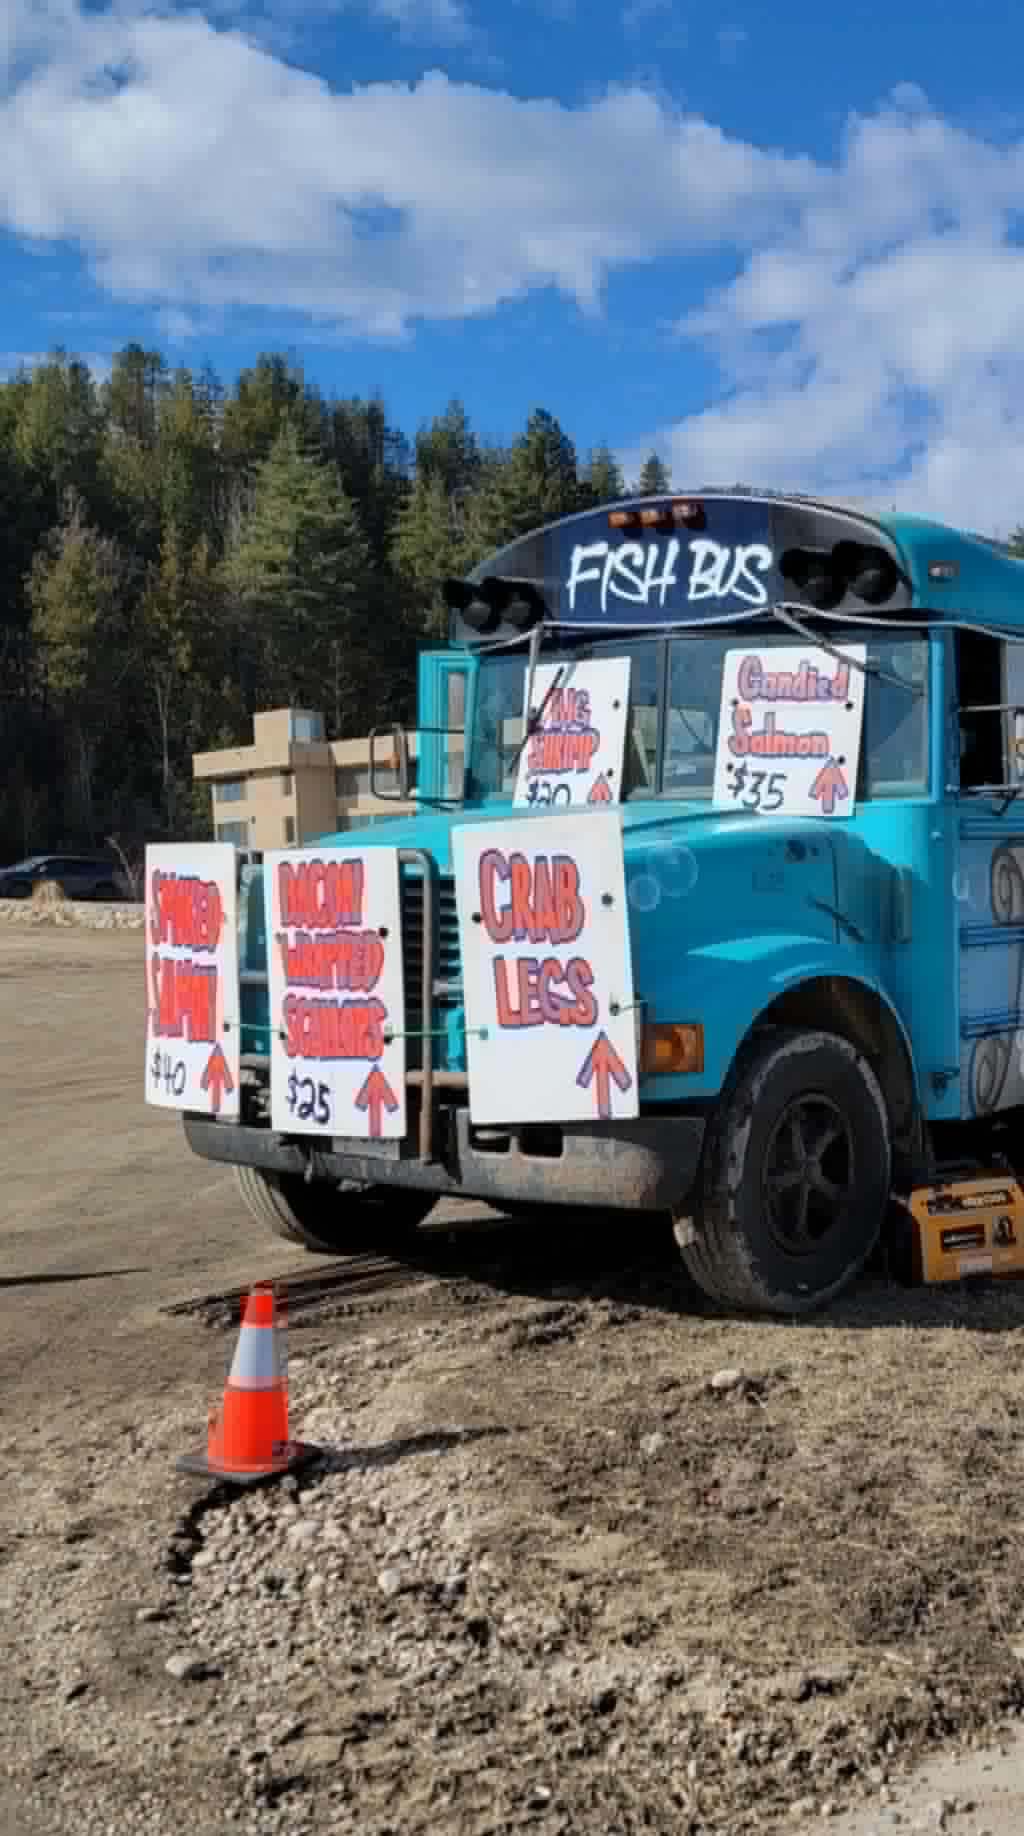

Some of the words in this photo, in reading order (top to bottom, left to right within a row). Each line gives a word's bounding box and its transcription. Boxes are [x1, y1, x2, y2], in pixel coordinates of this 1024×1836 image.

[566, 538, 680, 613] FISH
[688, 539, 774, 604] BUS
[737, 655, 849, 702] Candied
[728, 704, 830, 759] Salmon
[727, 761, 788, 811] $35
[151, 869, 224, 953] SMOKED
[278, 857, 365, 928] BACON
[479, 848, 586, 944] CRAB
[275, 929, 386, 992] WRAPPED
[493, 954, 599, 1029] LEGS
[281, 992, 388, 1062] SCALLOPS
[150, 1049, 187, 1097] $40
[286, 1067, 331, 1124] $25
